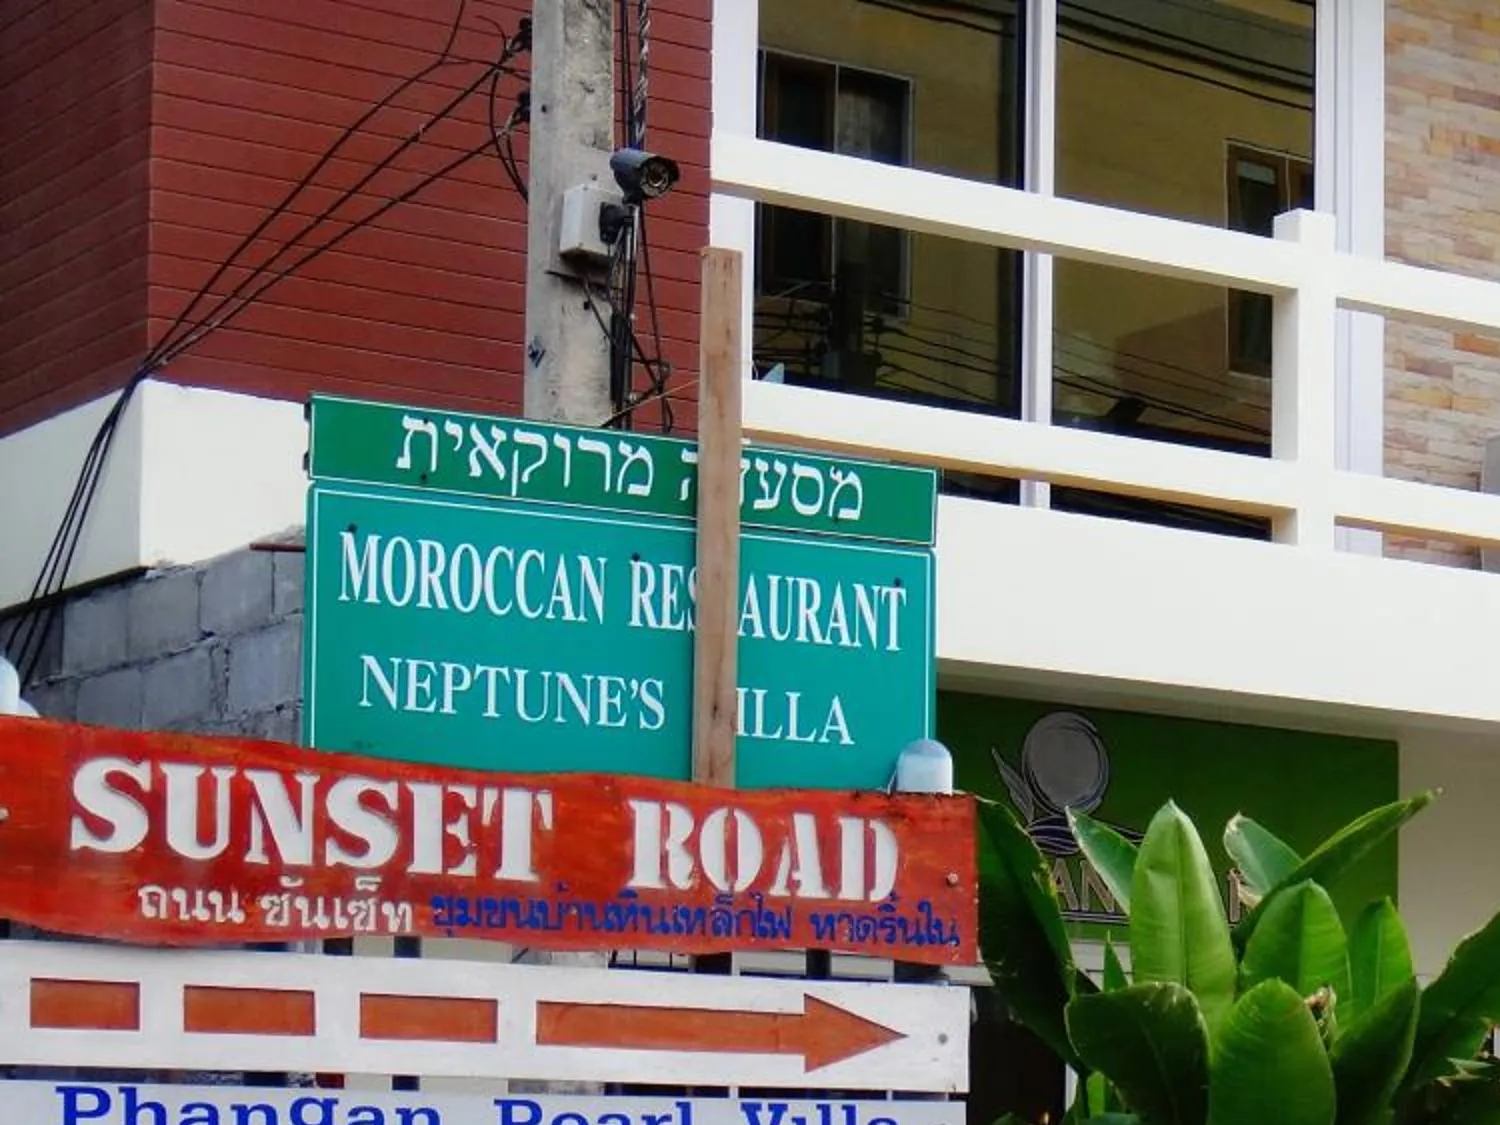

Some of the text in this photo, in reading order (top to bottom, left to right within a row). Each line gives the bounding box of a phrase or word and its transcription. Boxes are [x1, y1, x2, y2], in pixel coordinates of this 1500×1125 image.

[396, 413, 655, 498] מרוקאית
[339, 531, 907, 653] MOROCCAN REAURANT
[359, 655, 856, 746] NEPTUNE'S ILLA
[70, 756, 898, 901] SUNSET ROAD
[138, 884, 246, 923] ถนน
